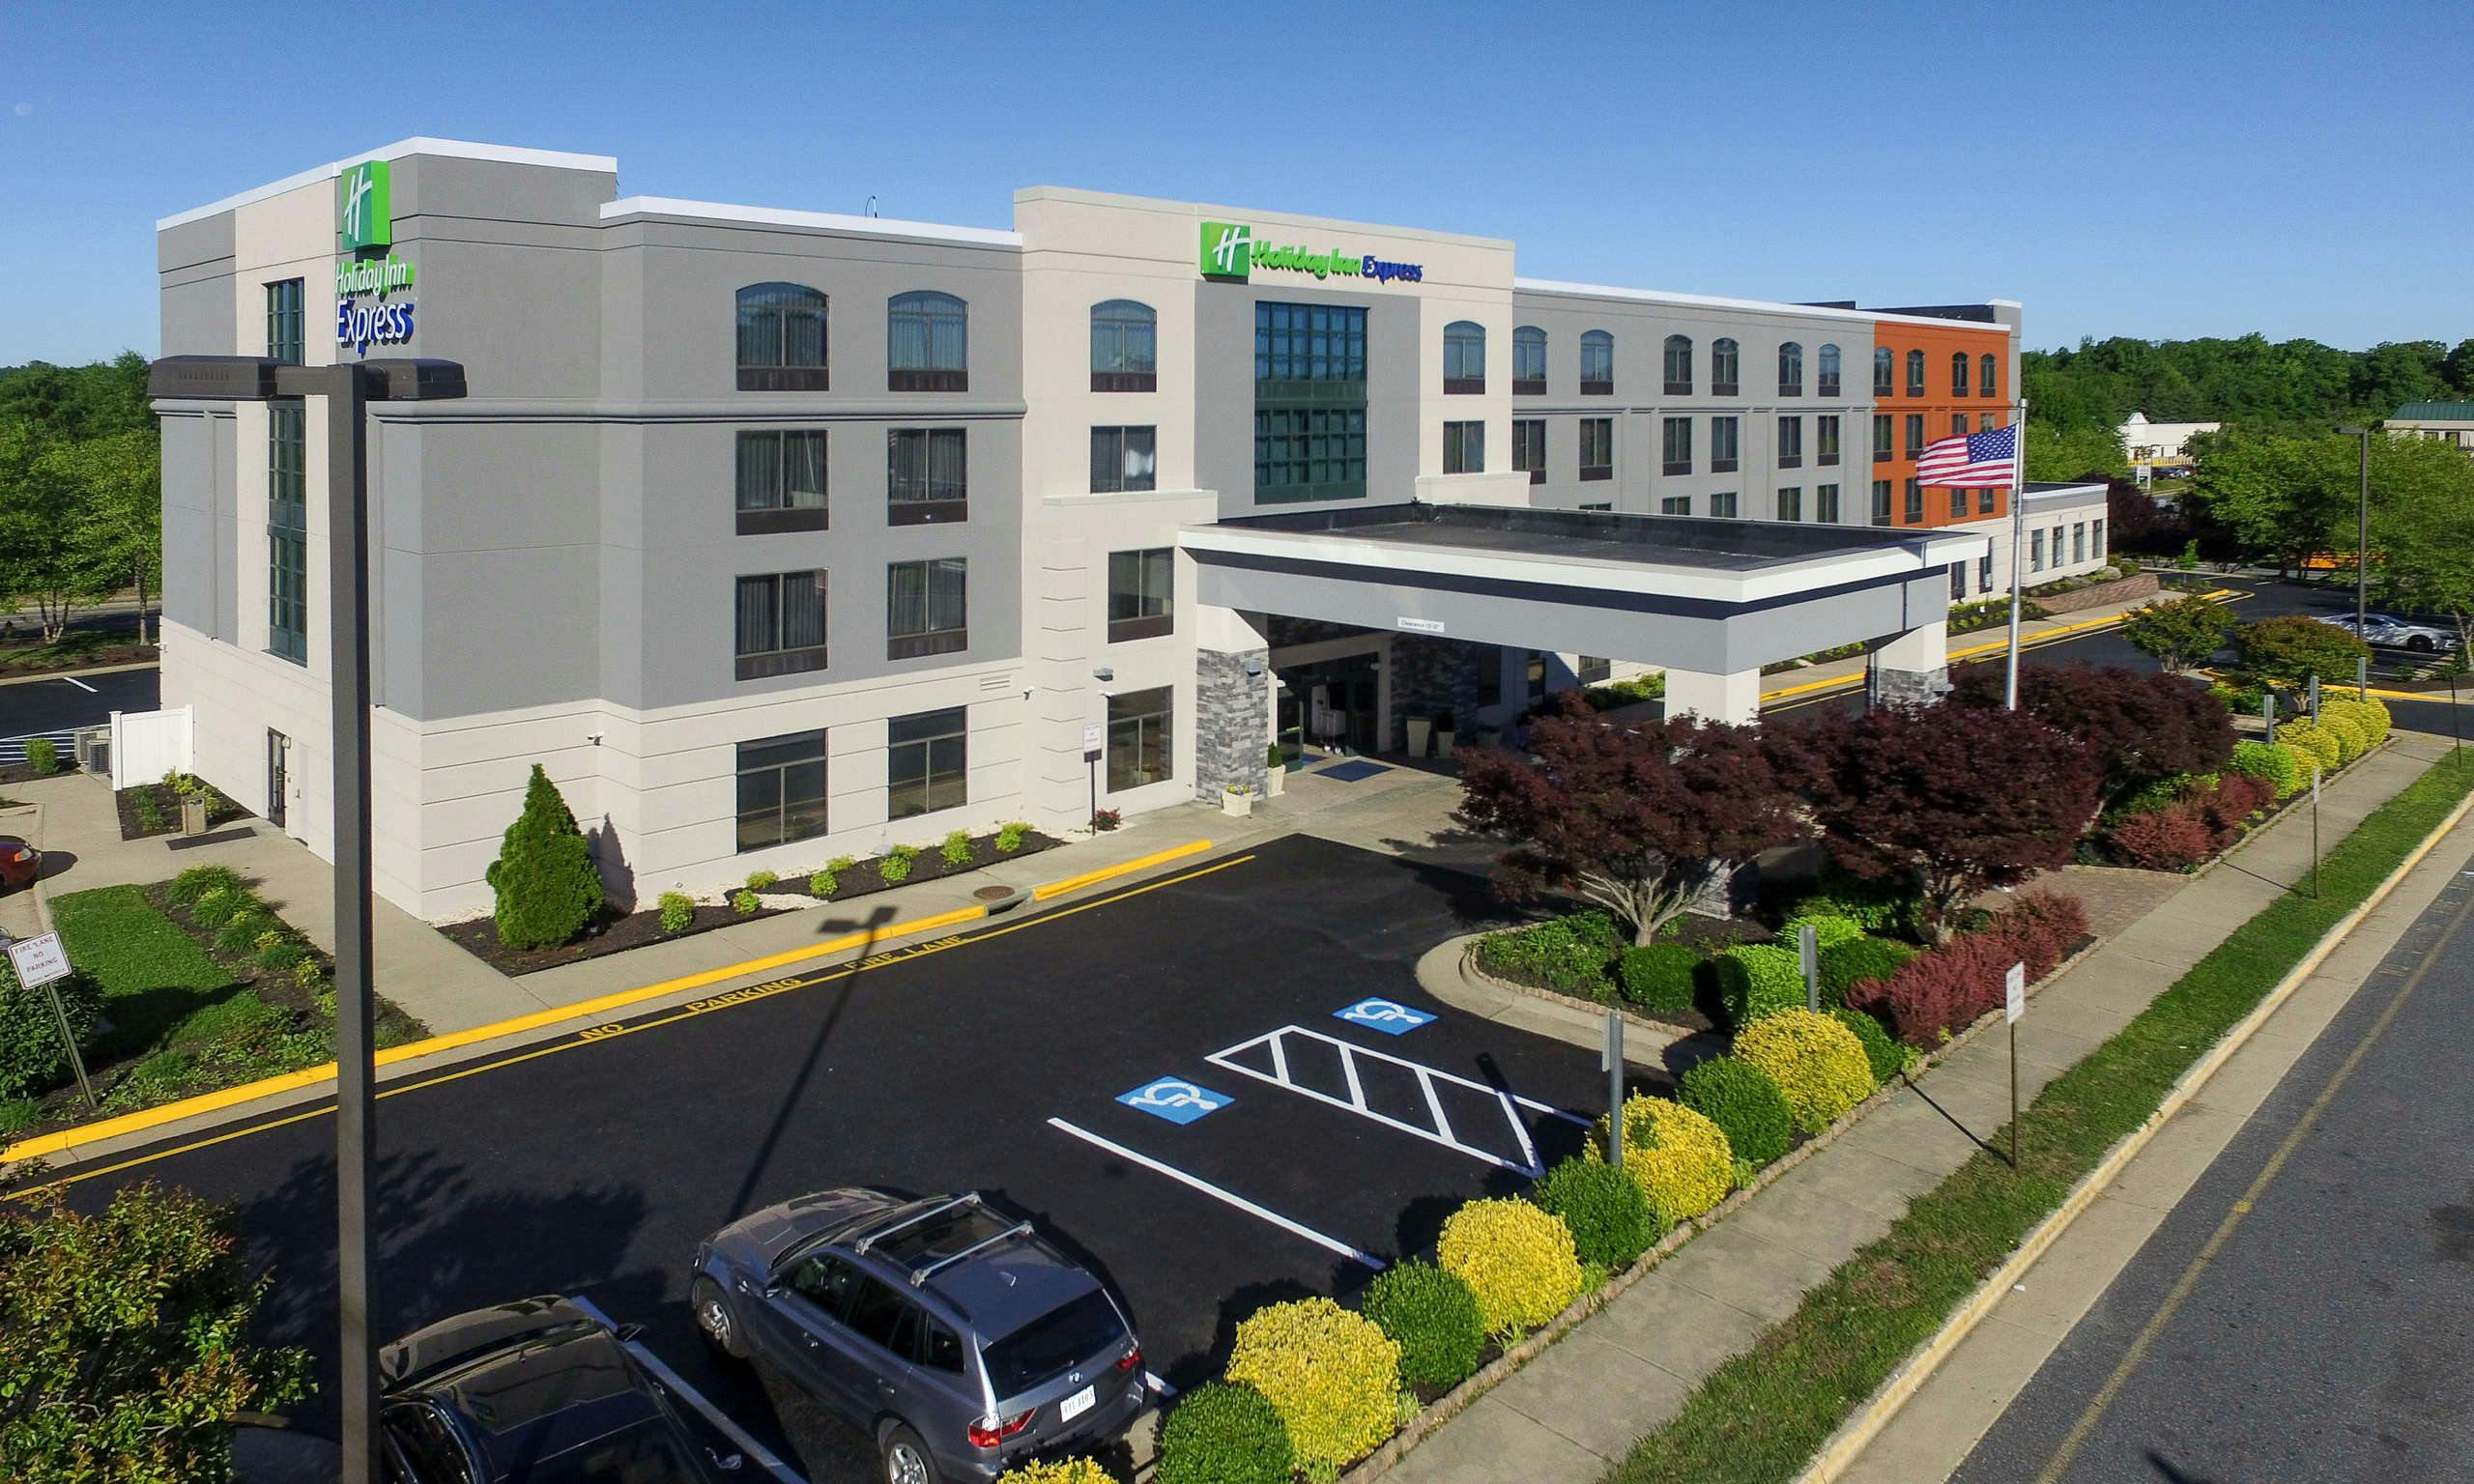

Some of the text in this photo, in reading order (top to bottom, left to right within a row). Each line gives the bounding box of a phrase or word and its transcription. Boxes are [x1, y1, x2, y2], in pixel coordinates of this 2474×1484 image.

[335, 253, 412, 297] Holiday Inn
[1251, 241, 1424, 285] Holiday Inn Express
[336, 298, 412, 357] Express
[14, 935, 55, 955] FIRE LANE
[26, 956, 59, 973] PARKING
[33, 951, 44, 959] NO
[580, 935, 967, 1041] NO PARKING FIRE LANE
